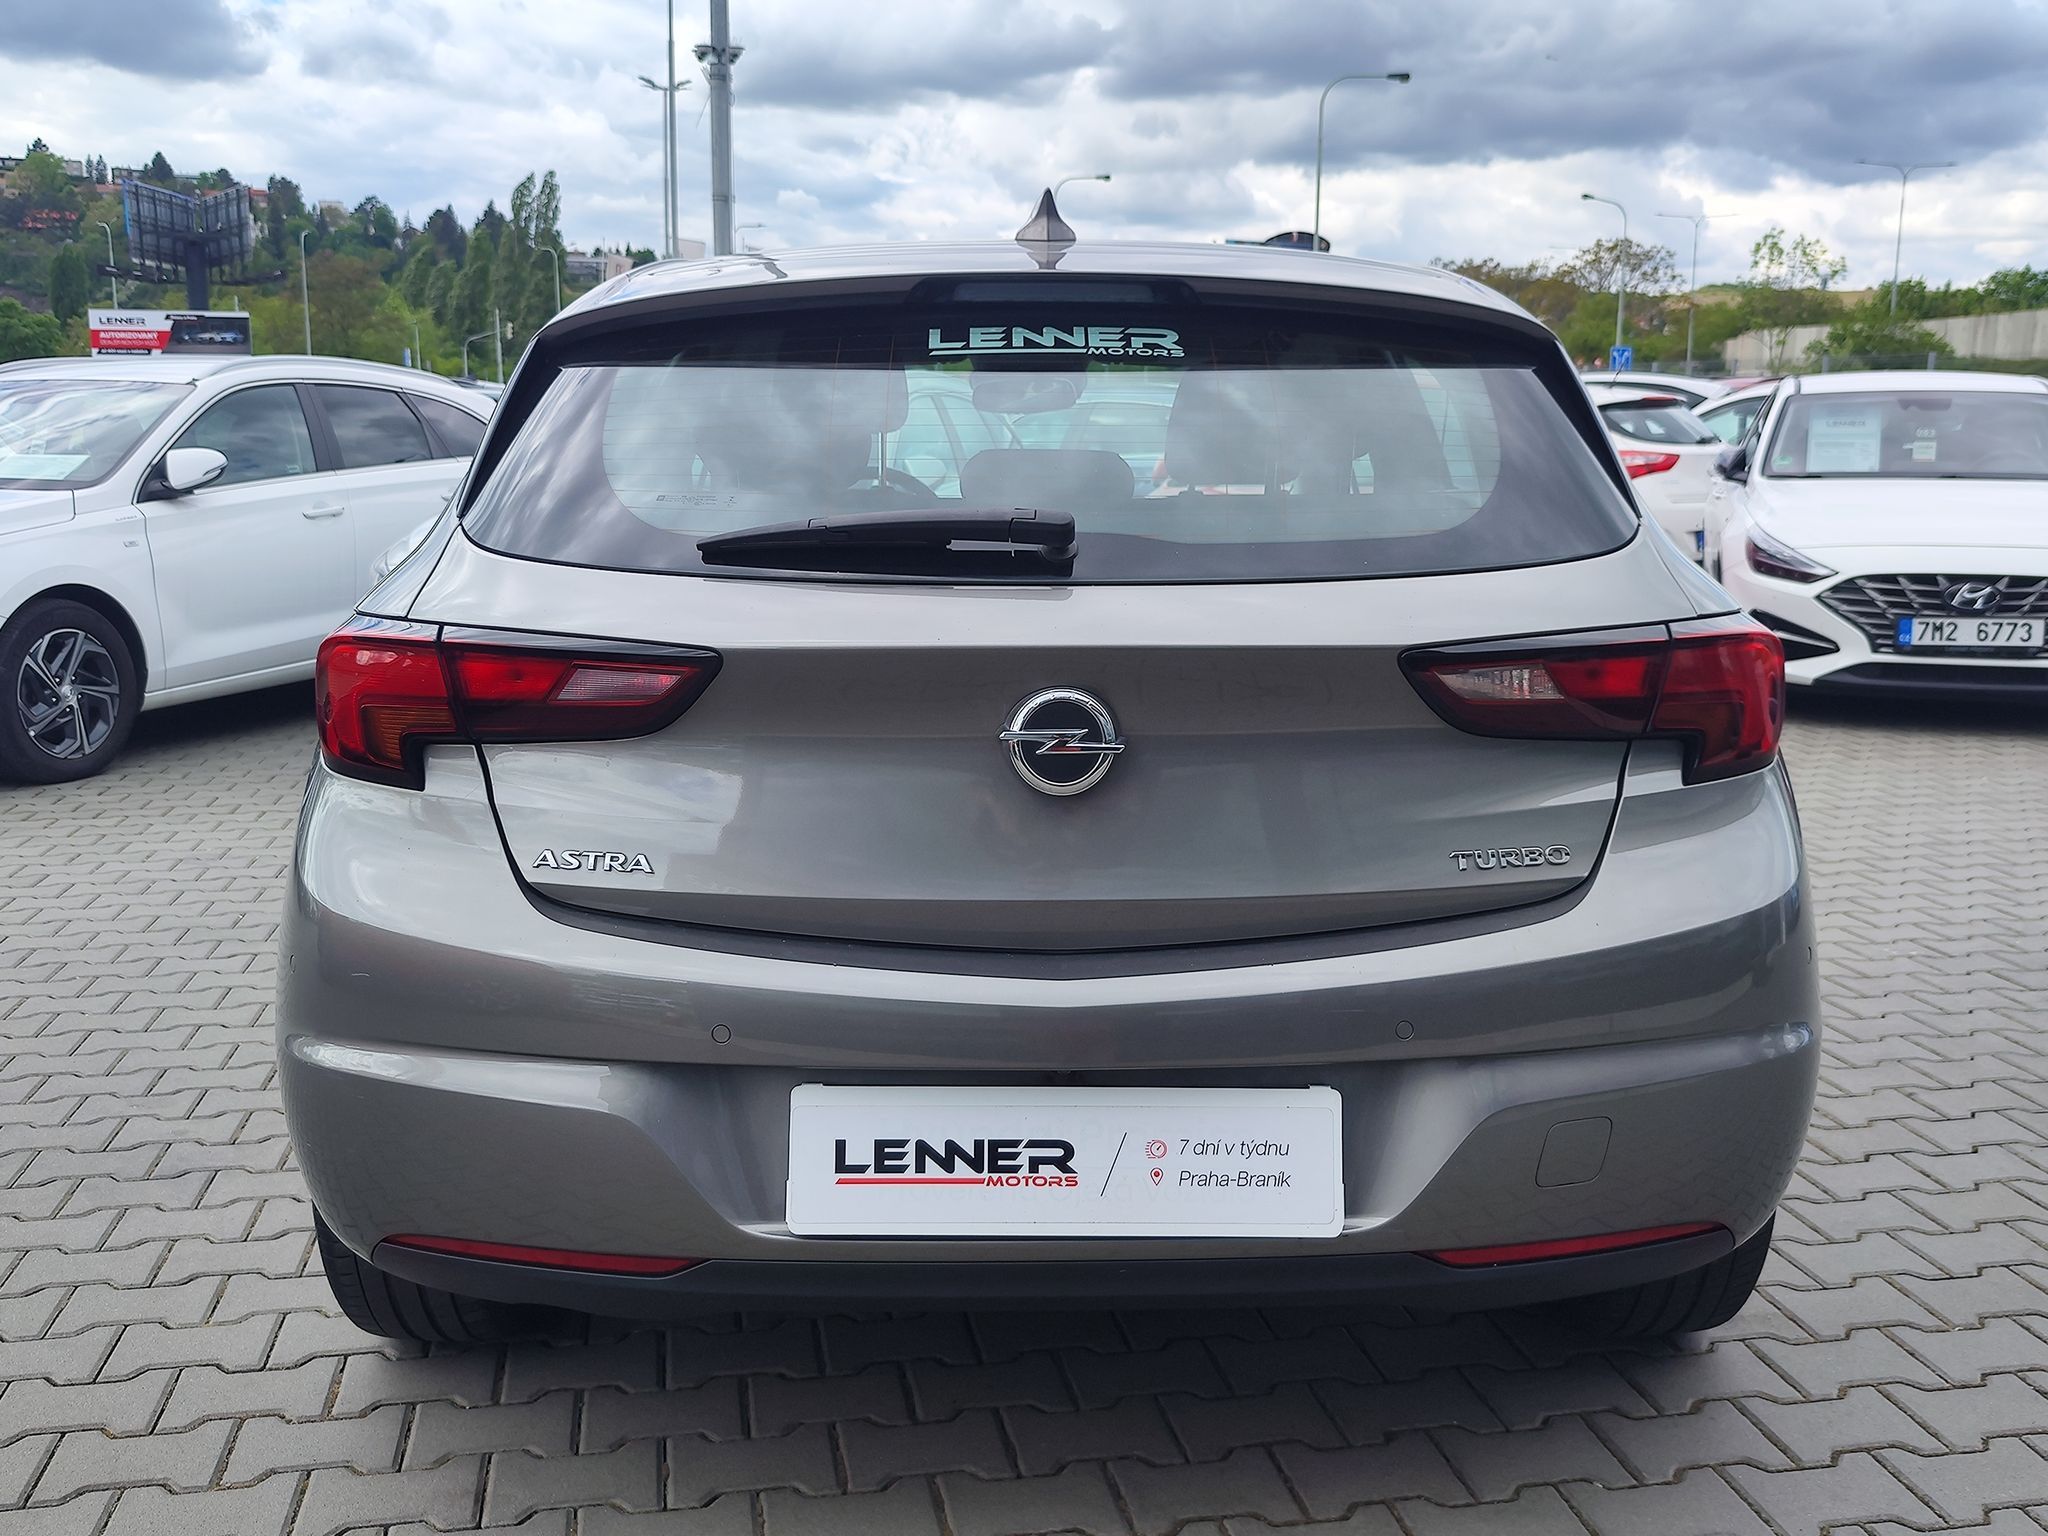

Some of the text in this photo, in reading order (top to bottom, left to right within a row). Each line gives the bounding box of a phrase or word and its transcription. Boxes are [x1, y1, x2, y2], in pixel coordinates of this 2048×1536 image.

[99, 316, 146, 326] LENNER
[928, 326, 1184, 350] LENNER
[1086, 346, 1186, 358] MOTORS
[1917, 621, 2033, 643] 7M2 6773
[532, 848, 655, 875] ASTRA
[1449, 843, 1571, 871] TURBO
[834, 1138, 1079, 1174] LENNER
[1179, 1139, 1290, 1160] 7 dní v týdnu
[985, 1175, 1079, 1187] MOTORS
[1178, 1170, 1292, 1188] Praha-Braník
